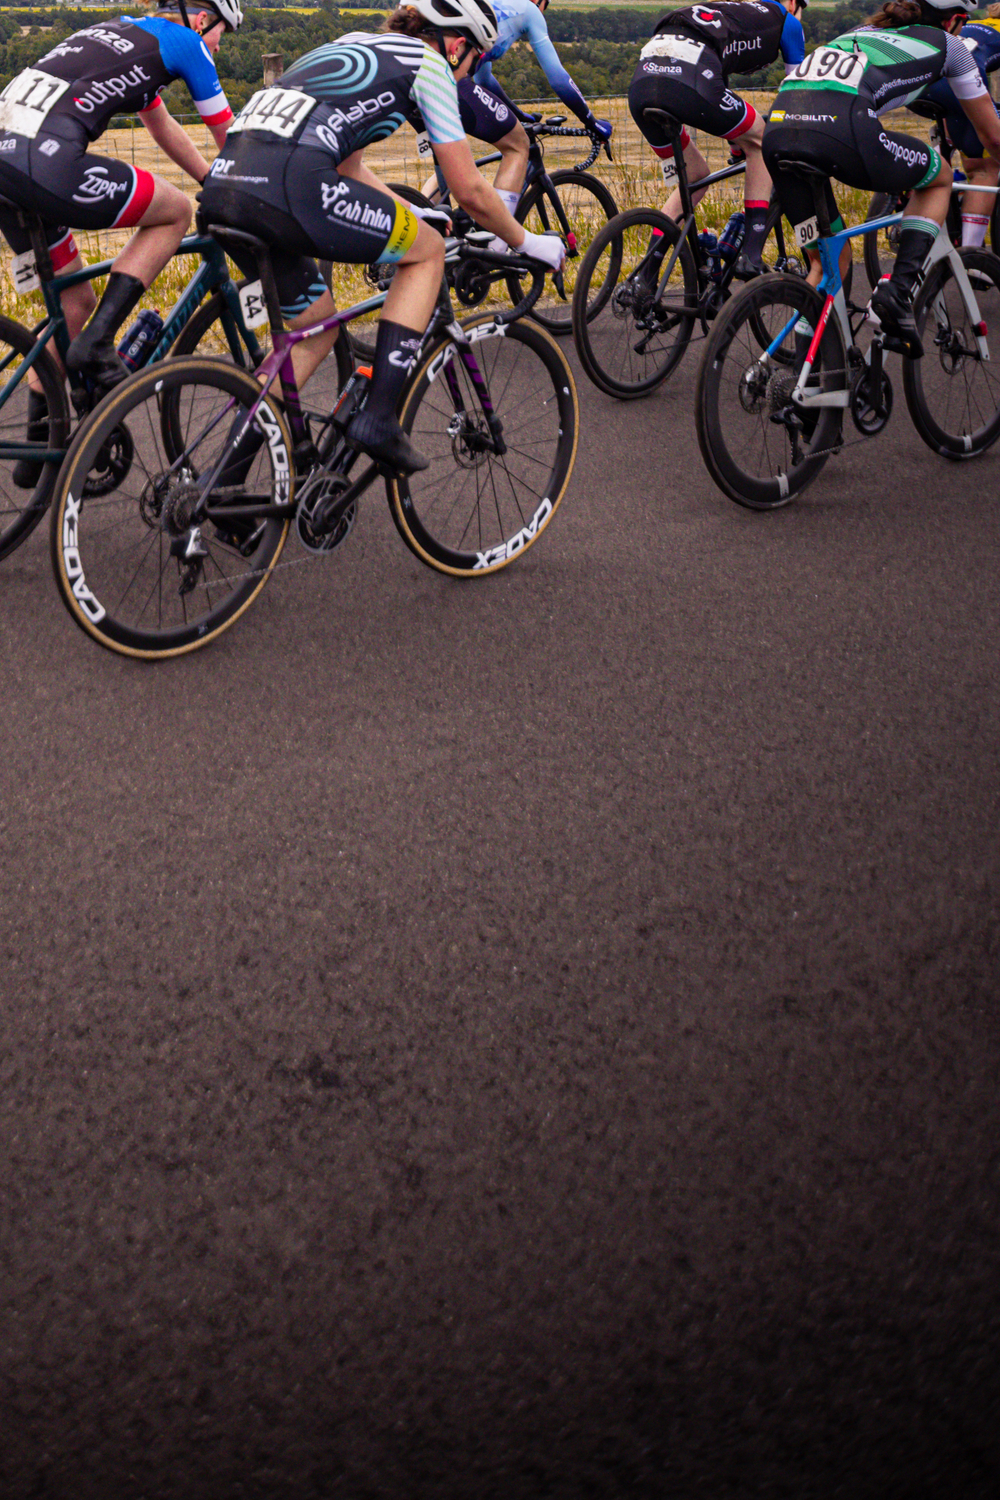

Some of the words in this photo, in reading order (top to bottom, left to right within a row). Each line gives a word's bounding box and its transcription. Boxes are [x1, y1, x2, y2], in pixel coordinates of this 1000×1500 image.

[648, 62, 682, 74] Stanza
[77, 64, 151, 113] output
[473, 85, 499, 112] AGU
[327, 90, 396, 132] elabo
[785, 113, 838, 123] MOBILITY
[663, 164, 676, 180] 51
[79, 174, 127, 199] ZZPR.nl
[800, 226, 814, 244] 90
[16, 264, 34, 285] 11
[244, 294, 262, 319] 44
[473, 497, 553, 570] CADEX
[64, 491, 106, 624] CADEX
